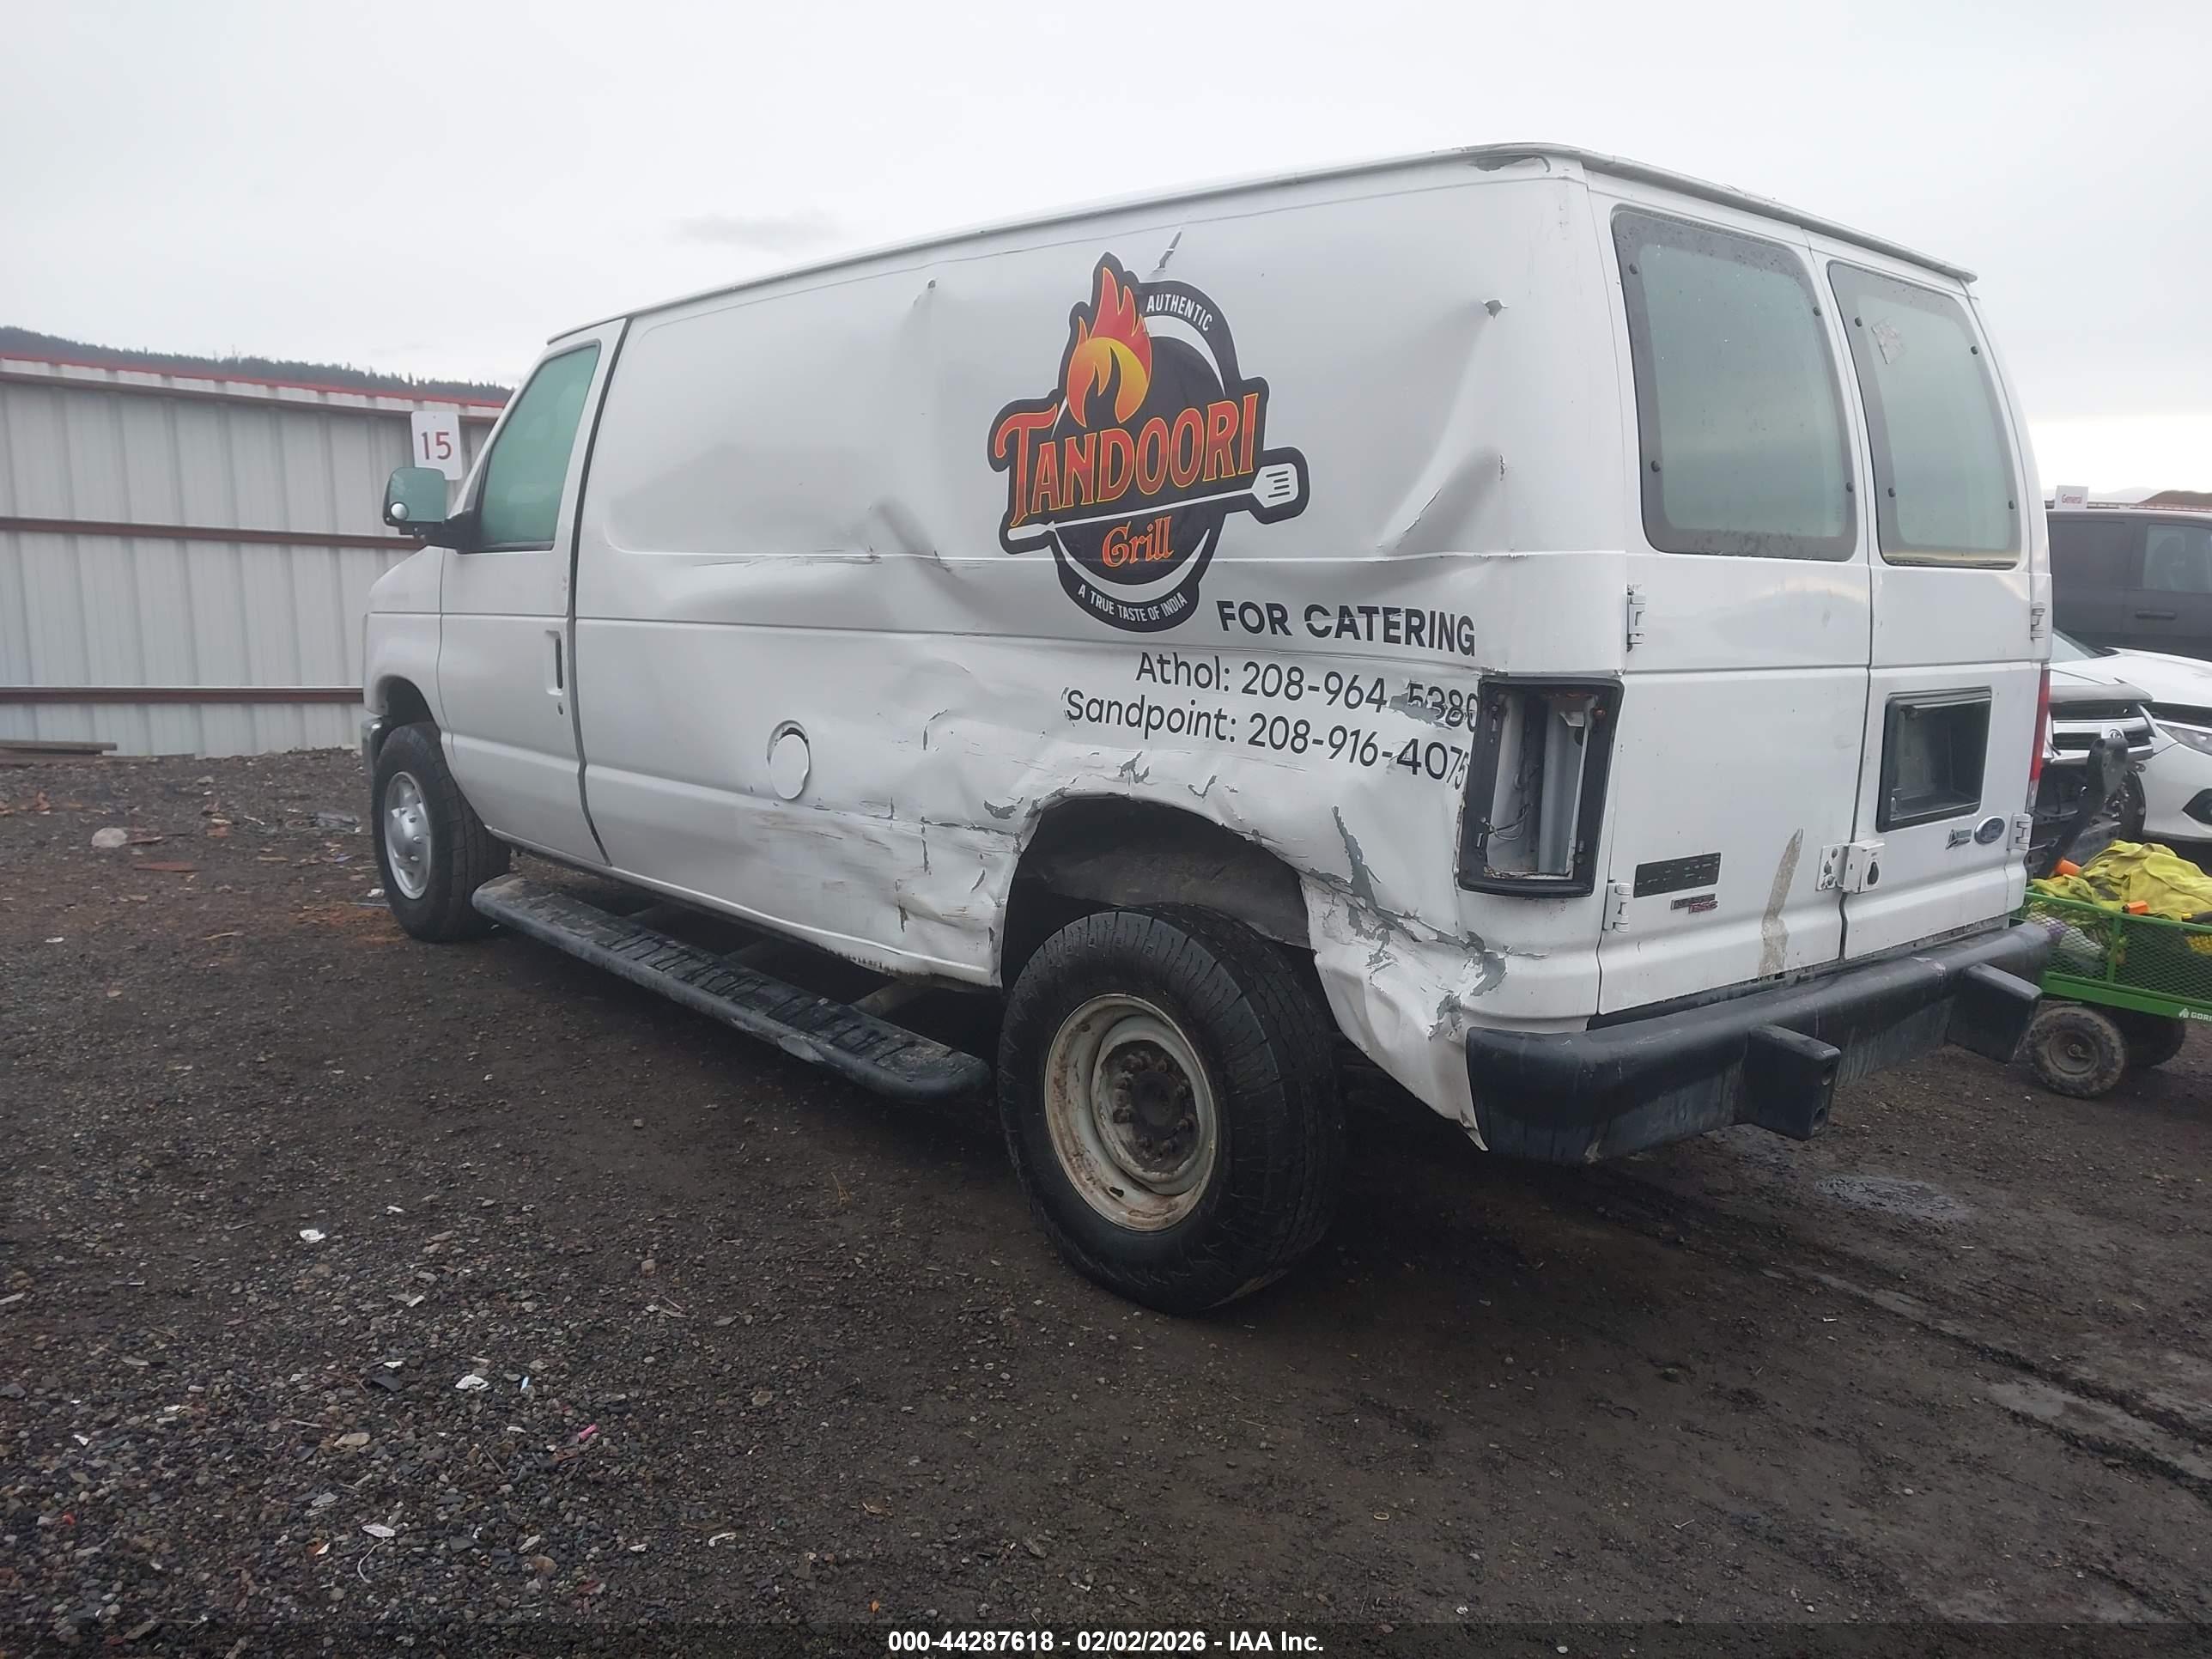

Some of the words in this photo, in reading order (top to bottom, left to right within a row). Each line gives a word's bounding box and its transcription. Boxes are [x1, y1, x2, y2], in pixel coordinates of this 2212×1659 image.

[1146, 294, 1212, 331] AUTHENTIC
[421, 431, 453, 460] 15
[995, 392, 1260, 526] TANDOORI
[1102, 515, 1174, 568] Grill
[1078, 584, 1086, 599] A
[1091, 590, 1115, 616] TRUE
[1117, 604, 1148, 622] TASTE
[1147, 605, 1160, 621] OF
[1160, 592, 1188, 617] INDIA
[1216, 600, 1293, 636] FOR
[1304, 604, 1476, 657] CATERING
[1136, 652, 1231, 692] Athol:
[1066, 690, 1237, 742] Sandpoint:
[1248, 712, 1469, 790] 208-916-4075
